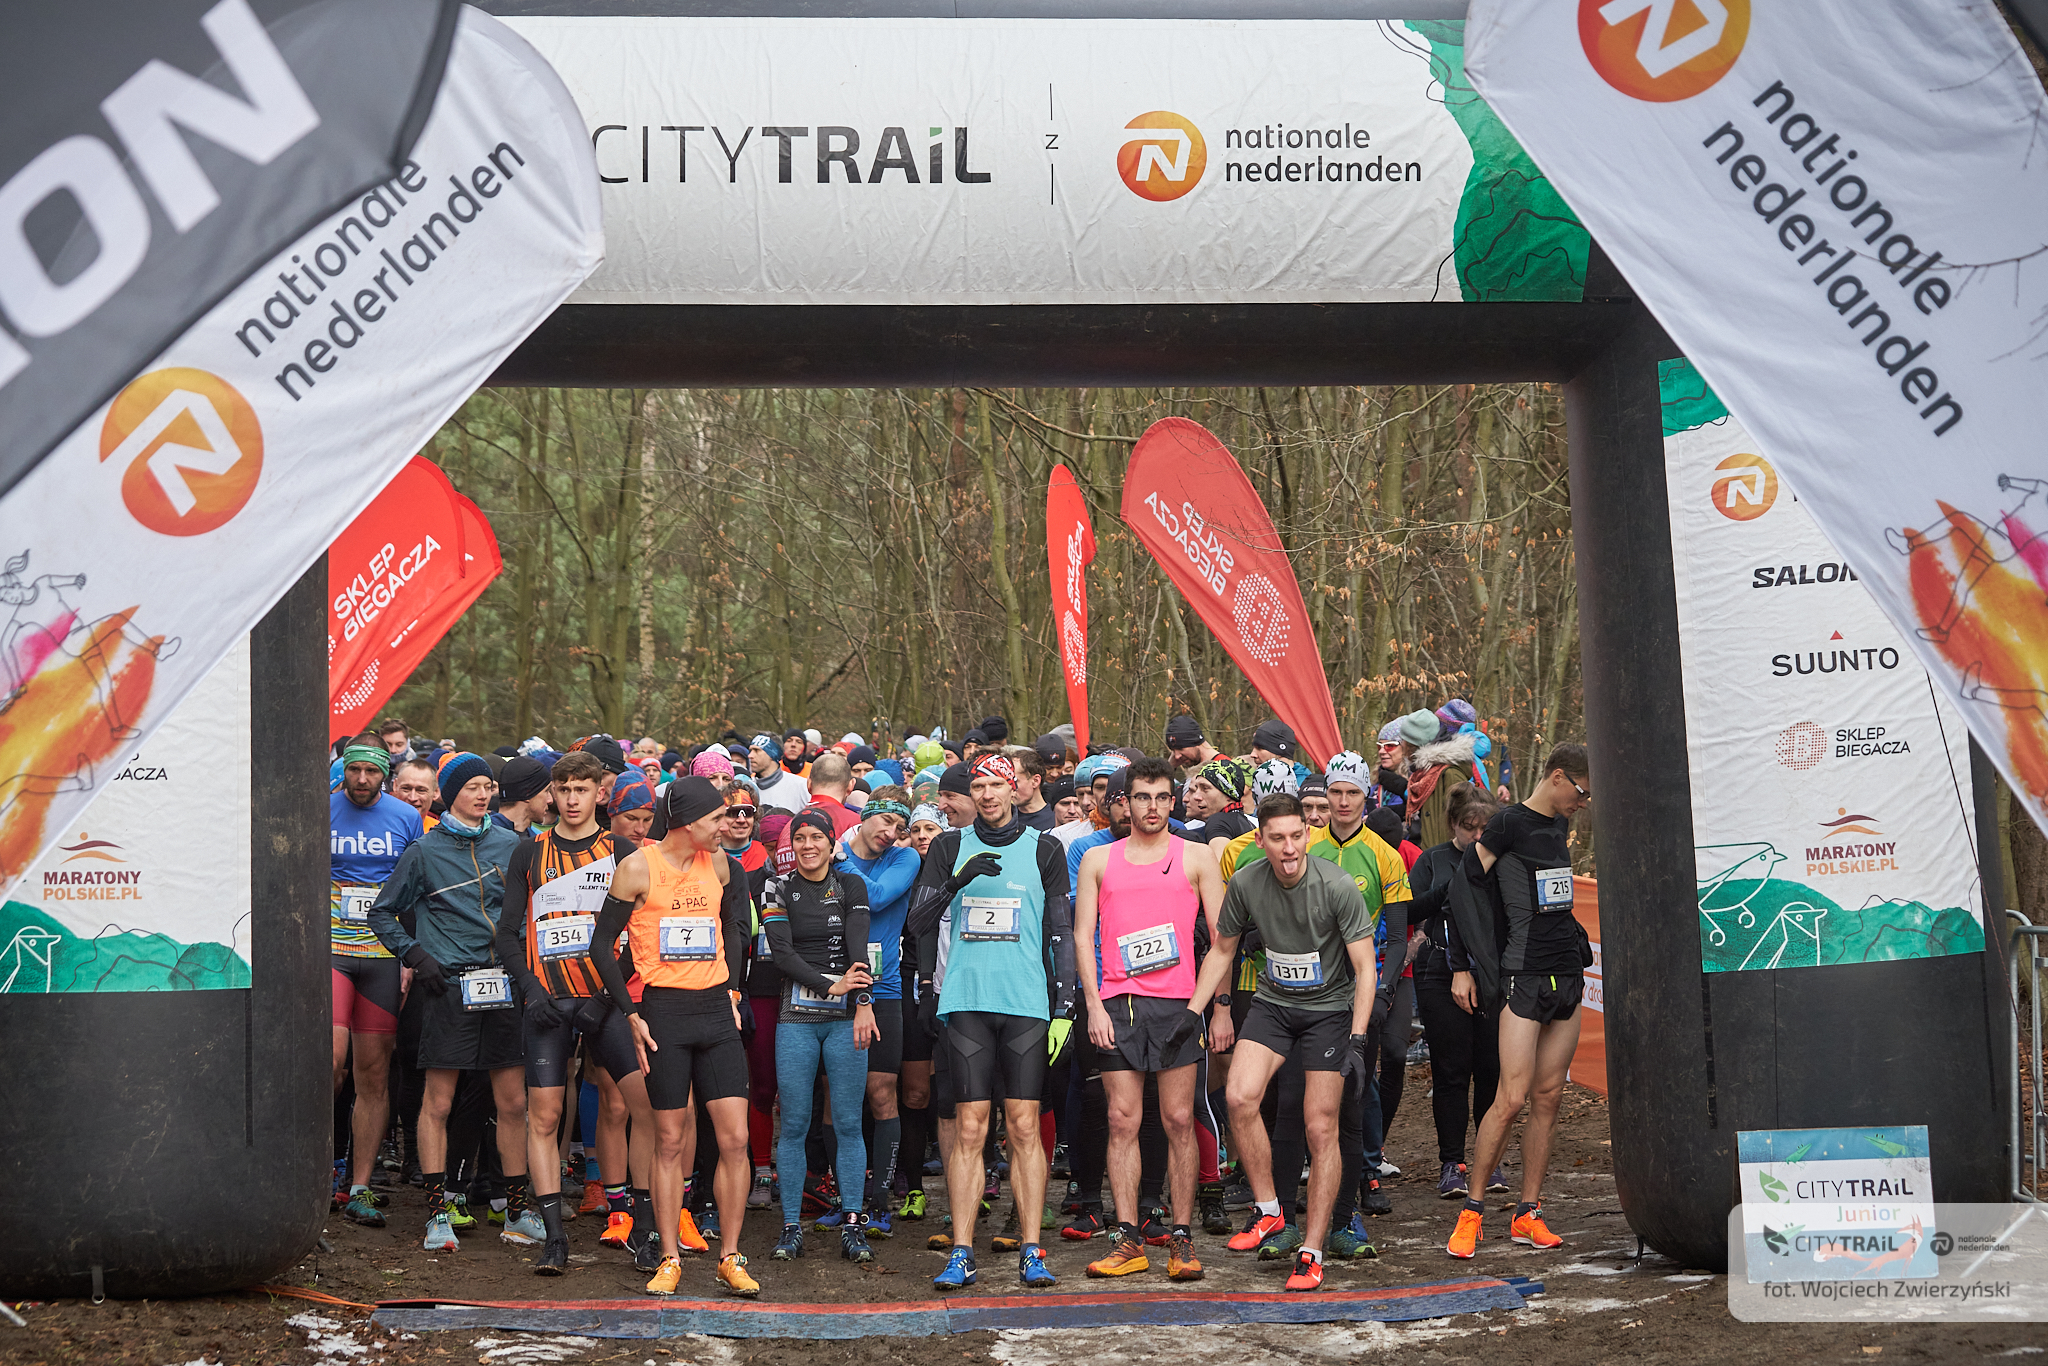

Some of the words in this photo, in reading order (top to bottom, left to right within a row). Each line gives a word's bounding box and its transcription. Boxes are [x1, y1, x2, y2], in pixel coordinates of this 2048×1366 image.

[1225, 122, 1371, 149] nationale
[1225, 154, 1423, 184] nederlanden
[0, 0, 320, 388] ON
[1752, 79, 1952, 316] nationale
[235, 158, 427, 358] nationale
[274, 141, 526, 402] nederlanden
[1702, 120, 1964, 437] nederlanden
[334, 542, 395, 619] SKLEP
[344, 534, 441, 642] BIEGACZA
[1771, 647, 1899, 676] SUUNTO
[1835, 727, 1886, 742] SKLEP
[1835, 741, 1911, 758] BIEGACZA
[113, 767, 168, 781] ACZA
[1805, 842, 1896, 861] MARATONY
[1806, 859, 1899, 876] POLSKIE.PL
[43, 871, 142, 885] MARATONY
[585, 872, 605, 883] TRI
[43, 887, 143, 901] POLSKIE.PL
[1552, 880, 1570, 895] 215
[985, 911, 995, 925] 2
[550, 929, 582, 945] 354
[680, 928, 694, 946] 7
[1133, 939, 1165, 959] 222
[1275, 965, 1308, 979] 1317
[476, 981, 499, 995] 271
[1837, 1204, 1901, 1222] Junior
